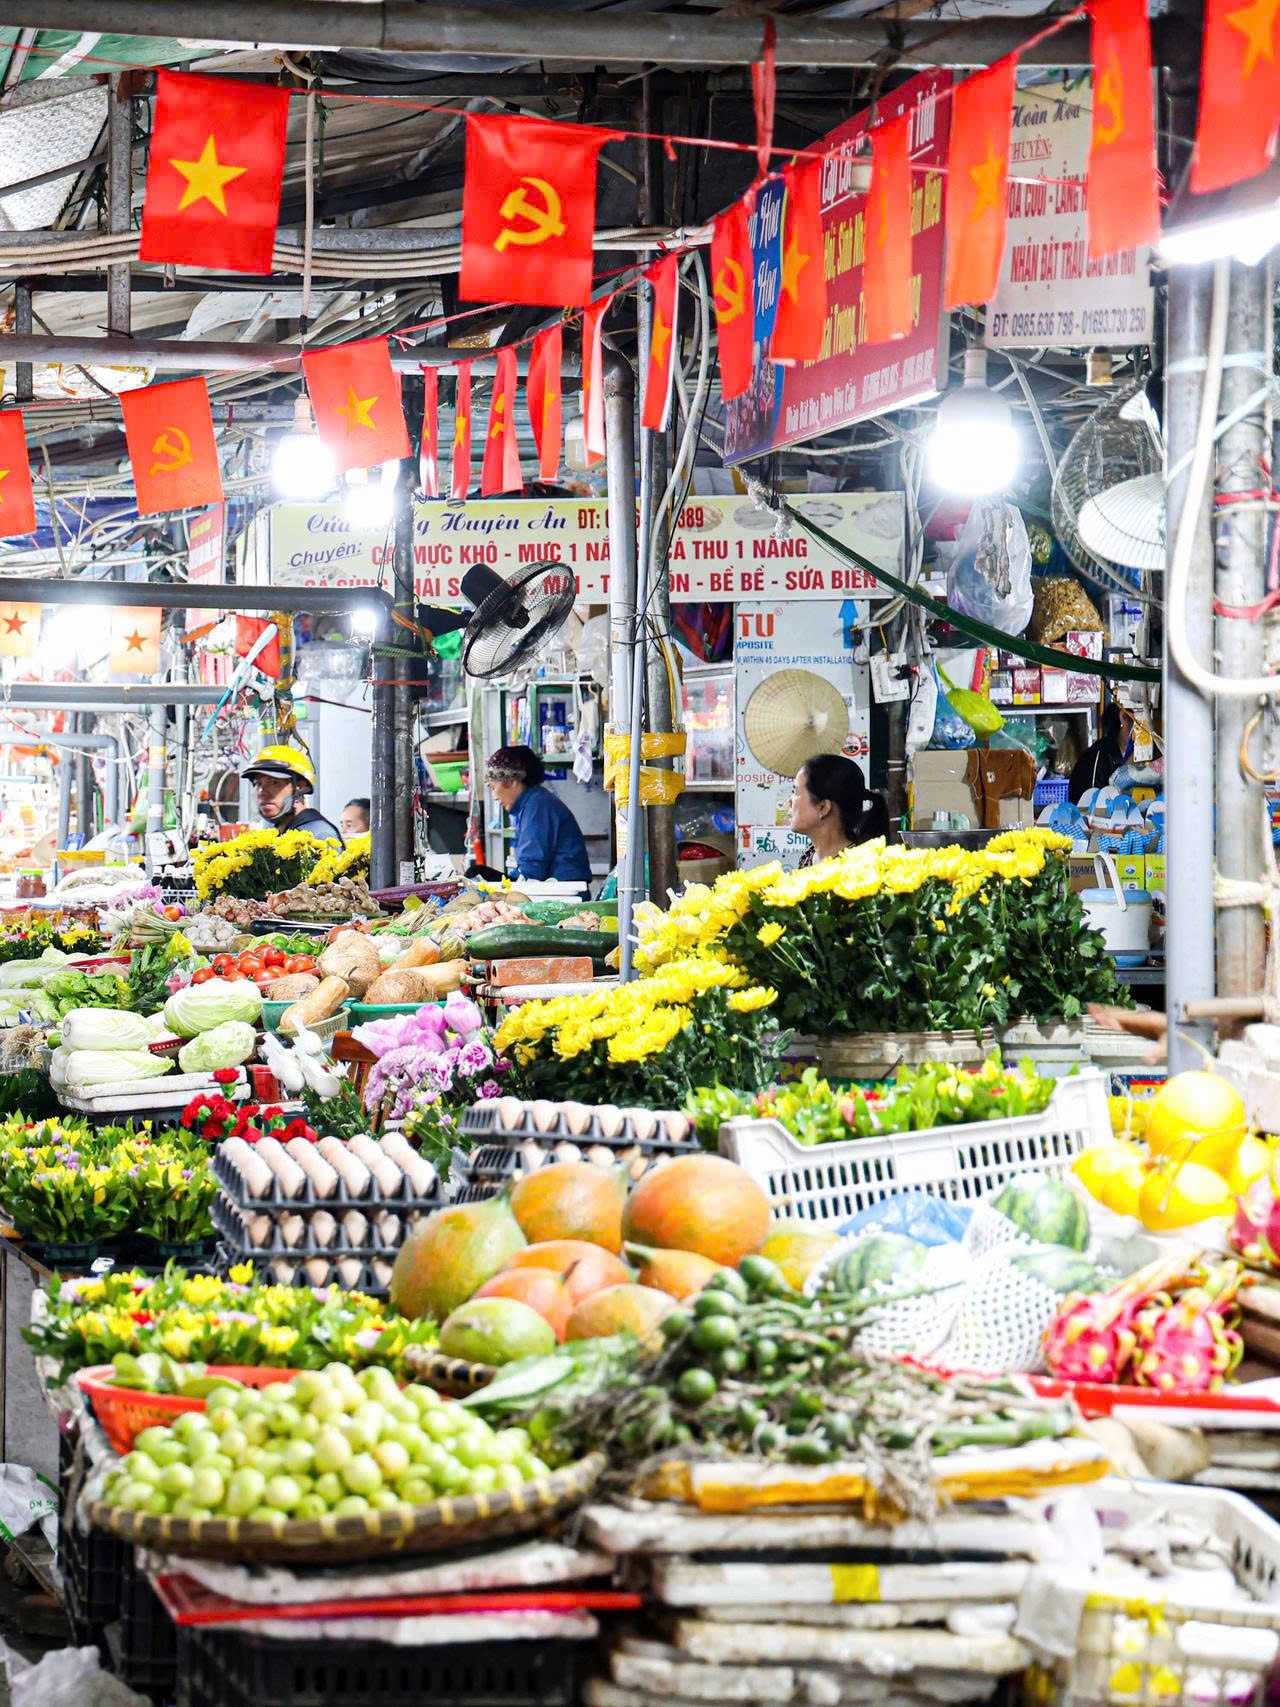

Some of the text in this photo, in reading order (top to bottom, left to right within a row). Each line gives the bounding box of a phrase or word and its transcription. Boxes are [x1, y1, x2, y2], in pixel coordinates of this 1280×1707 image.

[1011, 134, 1052, 160] HUYÊN:
[992, 313, 1009, 337] ĐT:
[577, 508, 600, 529] ĐT:
[459, 540, 498, 565] KHÔ
[569, 543, 577, 562] 1
[692, 540, 728, 560] THU
[735, 540, 744, 559] 1
[709, 565, 734, 592] BỀ
[740, 564, 765, 592] BỀ
[785, 565, 825, 590] SỨA
[813, 655, 855, 665] INSTALLATIO
